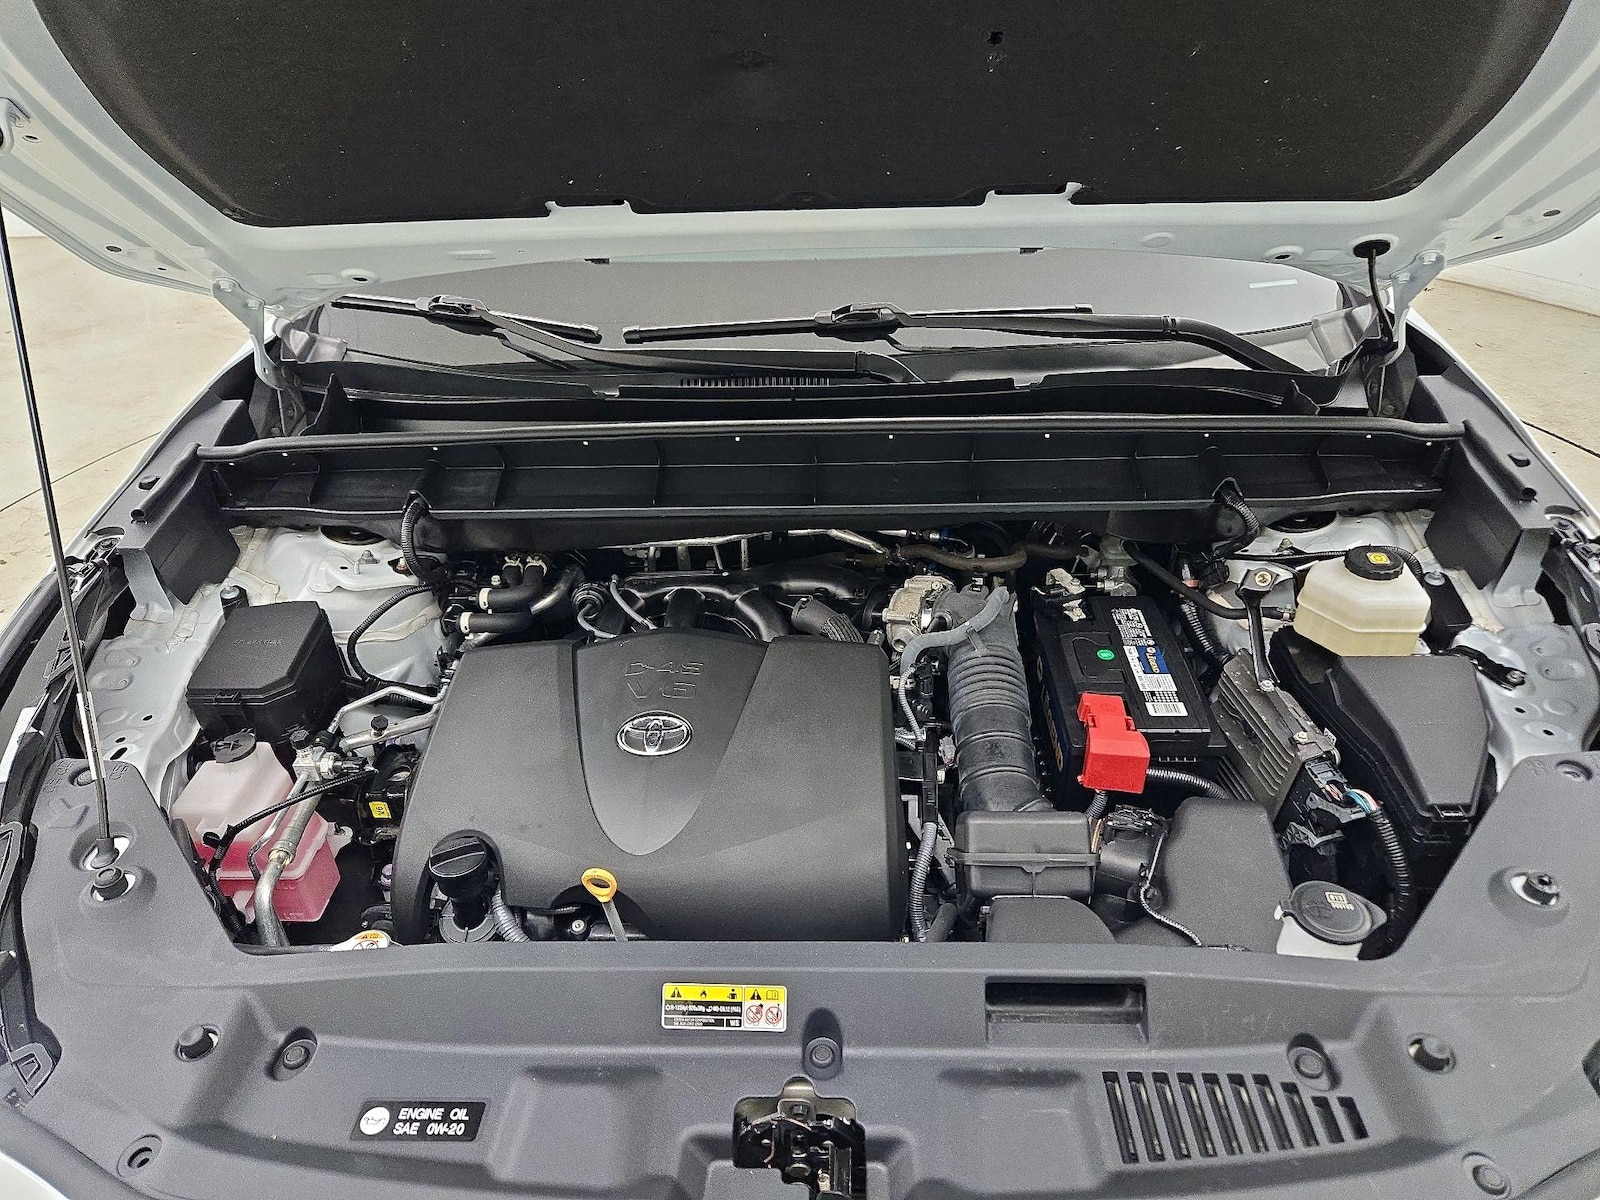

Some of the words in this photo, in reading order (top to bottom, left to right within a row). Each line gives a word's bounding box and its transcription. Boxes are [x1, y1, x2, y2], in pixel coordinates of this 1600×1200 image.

[626, 681, 697, 700] V6
[398, 1107, 445, 1121] ENGINE
[449, 1107, 470, 1121] OIL
[392, 1121, 421, 1136] SAE
[426, 1122, 466, 1136] 0W-20
